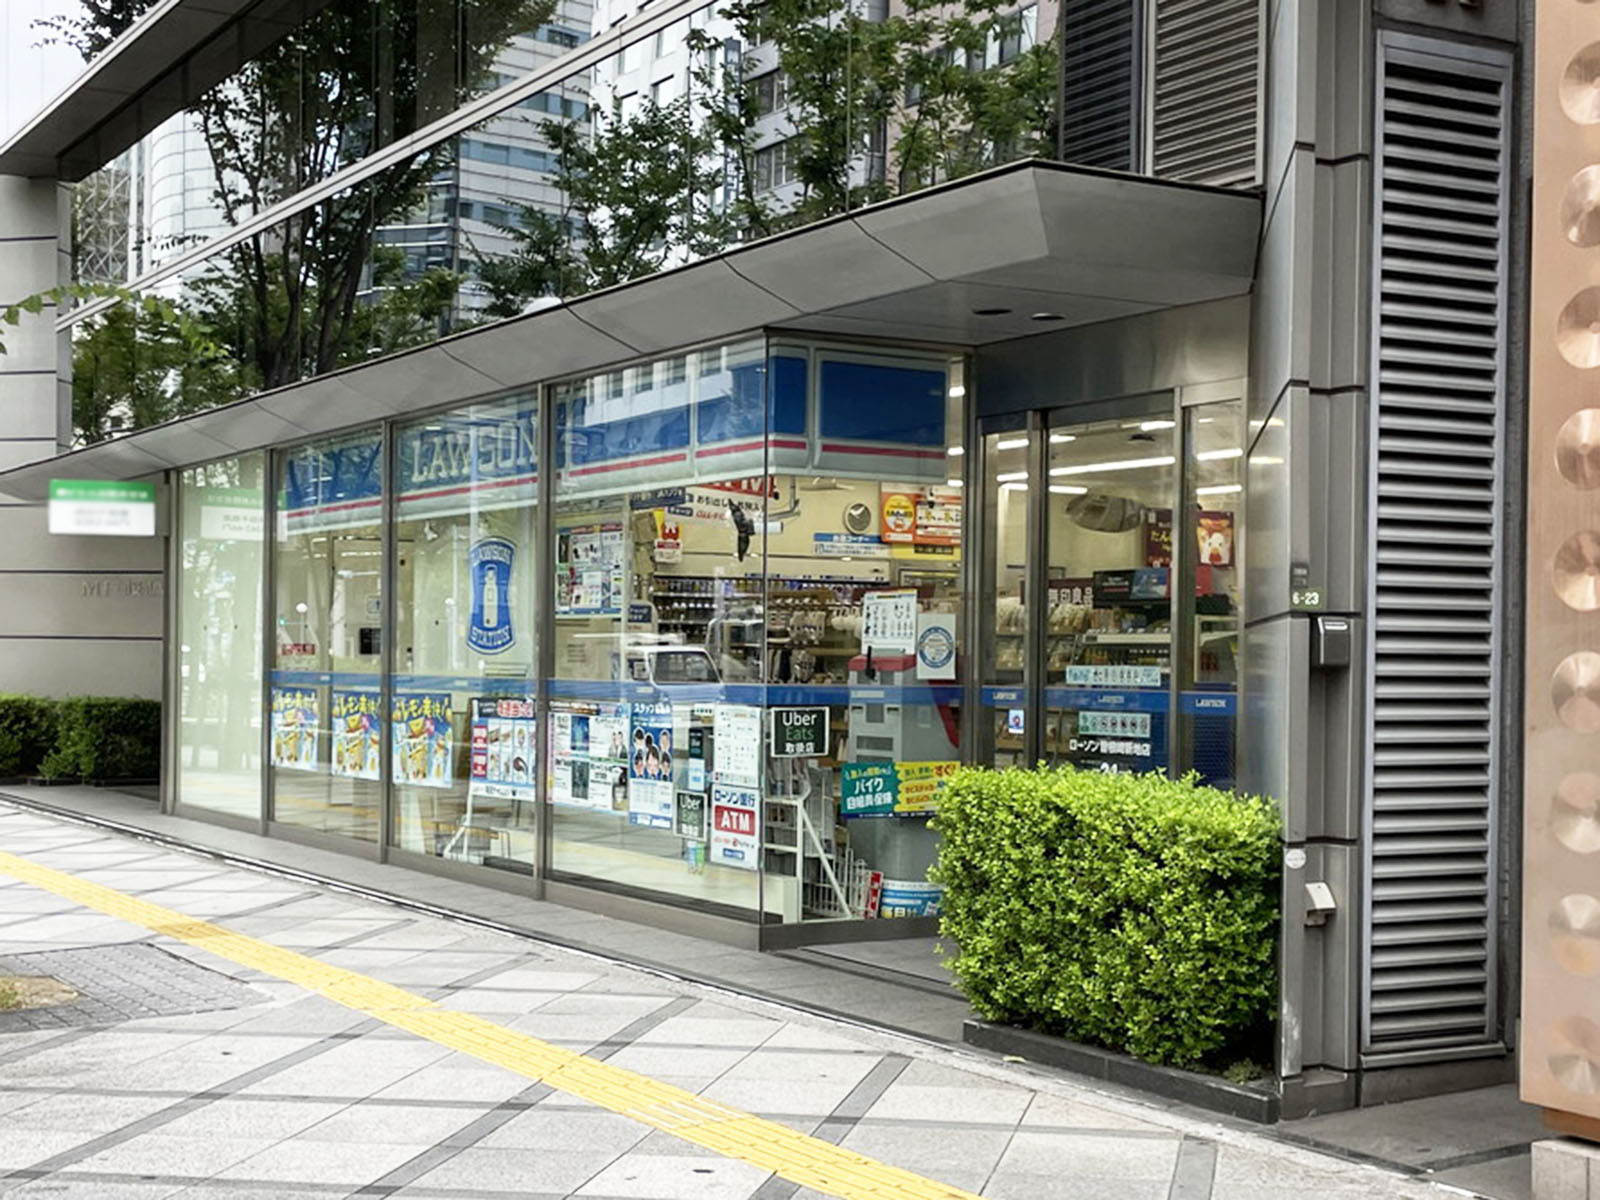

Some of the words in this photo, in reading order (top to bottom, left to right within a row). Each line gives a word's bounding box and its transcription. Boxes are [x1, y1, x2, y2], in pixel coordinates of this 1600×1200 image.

[411, 418, 538, 483] LAWSON
[1292, 591, 1319, 605] 6-23
[782, 712, 817, 726] Uber
[786, 727, 815, 742] Eats
[854, 777, 884, 794] バイク
[679, 794, 701, 809] Uber
[713, 789, 755, 808] ローソン銀行
[720, 809, 751, 832] ATM
